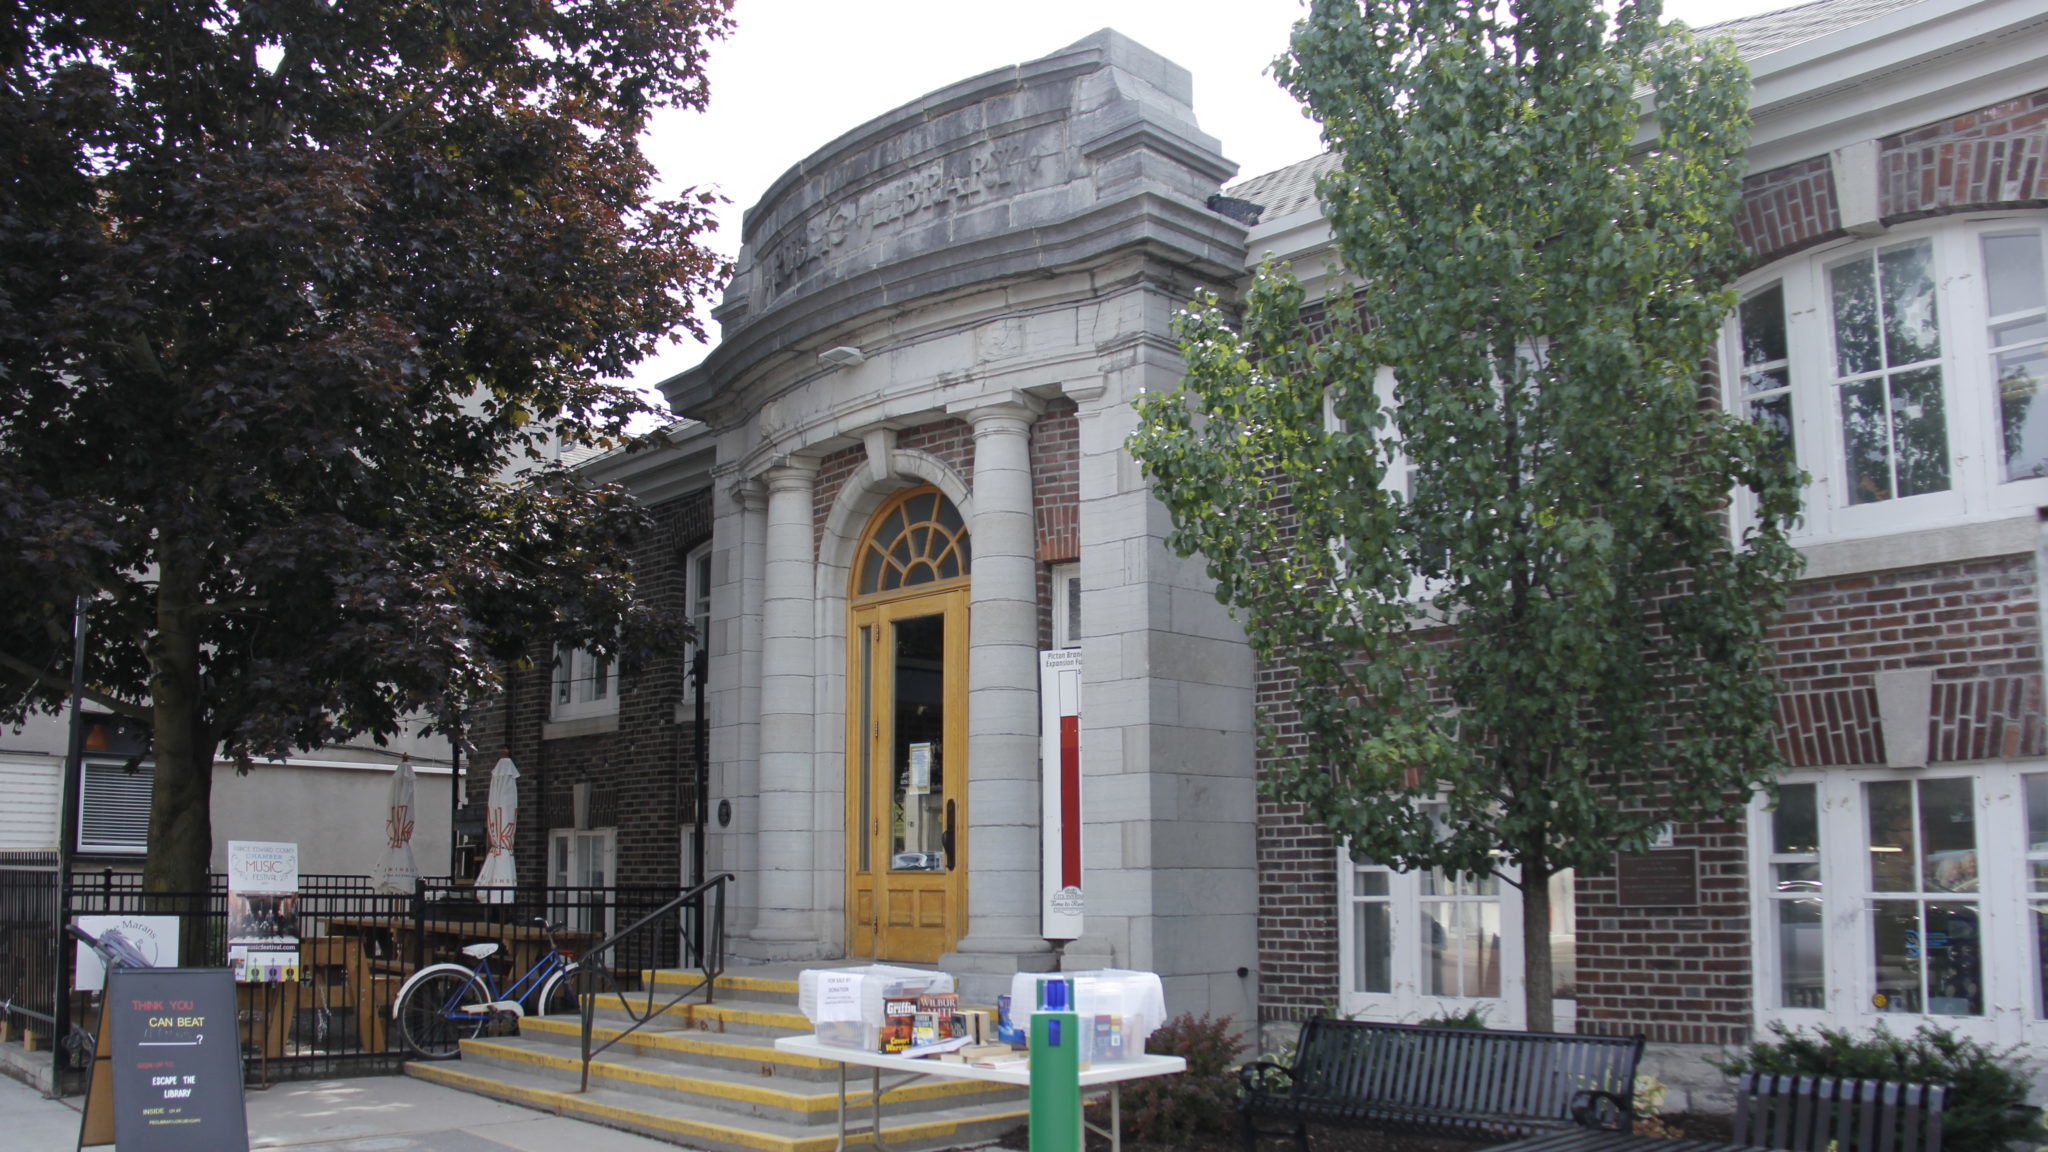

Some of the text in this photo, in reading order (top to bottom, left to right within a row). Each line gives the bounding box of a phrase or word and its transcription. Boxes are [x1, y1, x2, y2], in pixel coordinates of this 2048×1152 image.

[773, 144, 1021, 286] PUBLIC LIBRARY
[1047, 652, 1066, 660] Picton
[1046, 660, 1074, 669] Expansion
[245, 860, 284, 874] MUSIC
[252, 873, 279, 881] FESTIVAL
[122, 919, 157, 940] Marans
[131, 999, 195, 1011] THINK YOU
[886, 1001, 917, 1014] Griffin
[920, 997, 956, 1008] WILBUR
[148, 1016, 206, 1028] CAN BEAT
[151, 1074, 197, 1087] ESCAPE THE
[163, 1087, 192, 1099] LIBRARY
[142, 1107, 164, 1116] INSIDE
